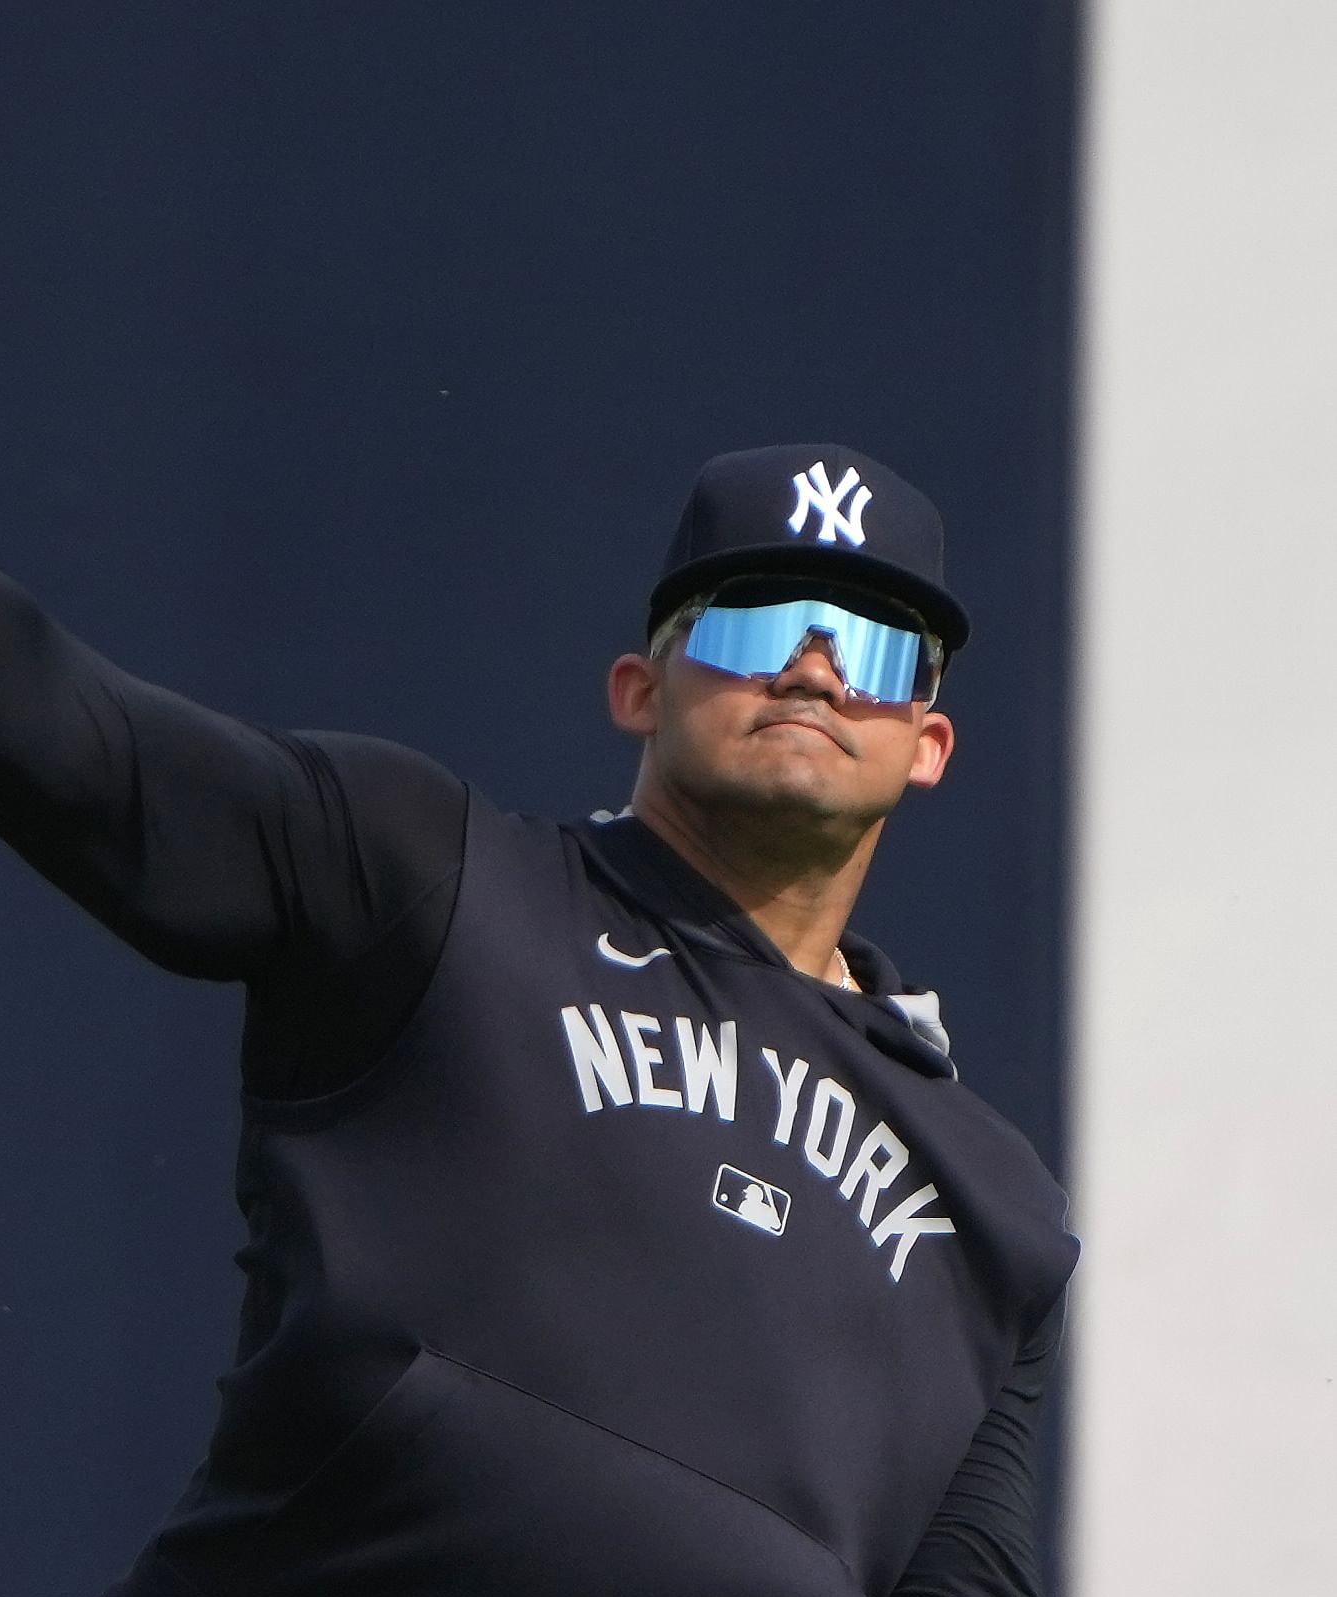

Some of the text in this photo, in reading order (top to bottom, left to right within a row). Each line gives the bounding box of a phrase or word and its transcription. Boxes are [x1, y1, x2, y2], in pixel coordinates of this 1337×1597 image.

[787, 460, 874, 547] NY
[560, 1003, 957, 1283] NEW YORK
